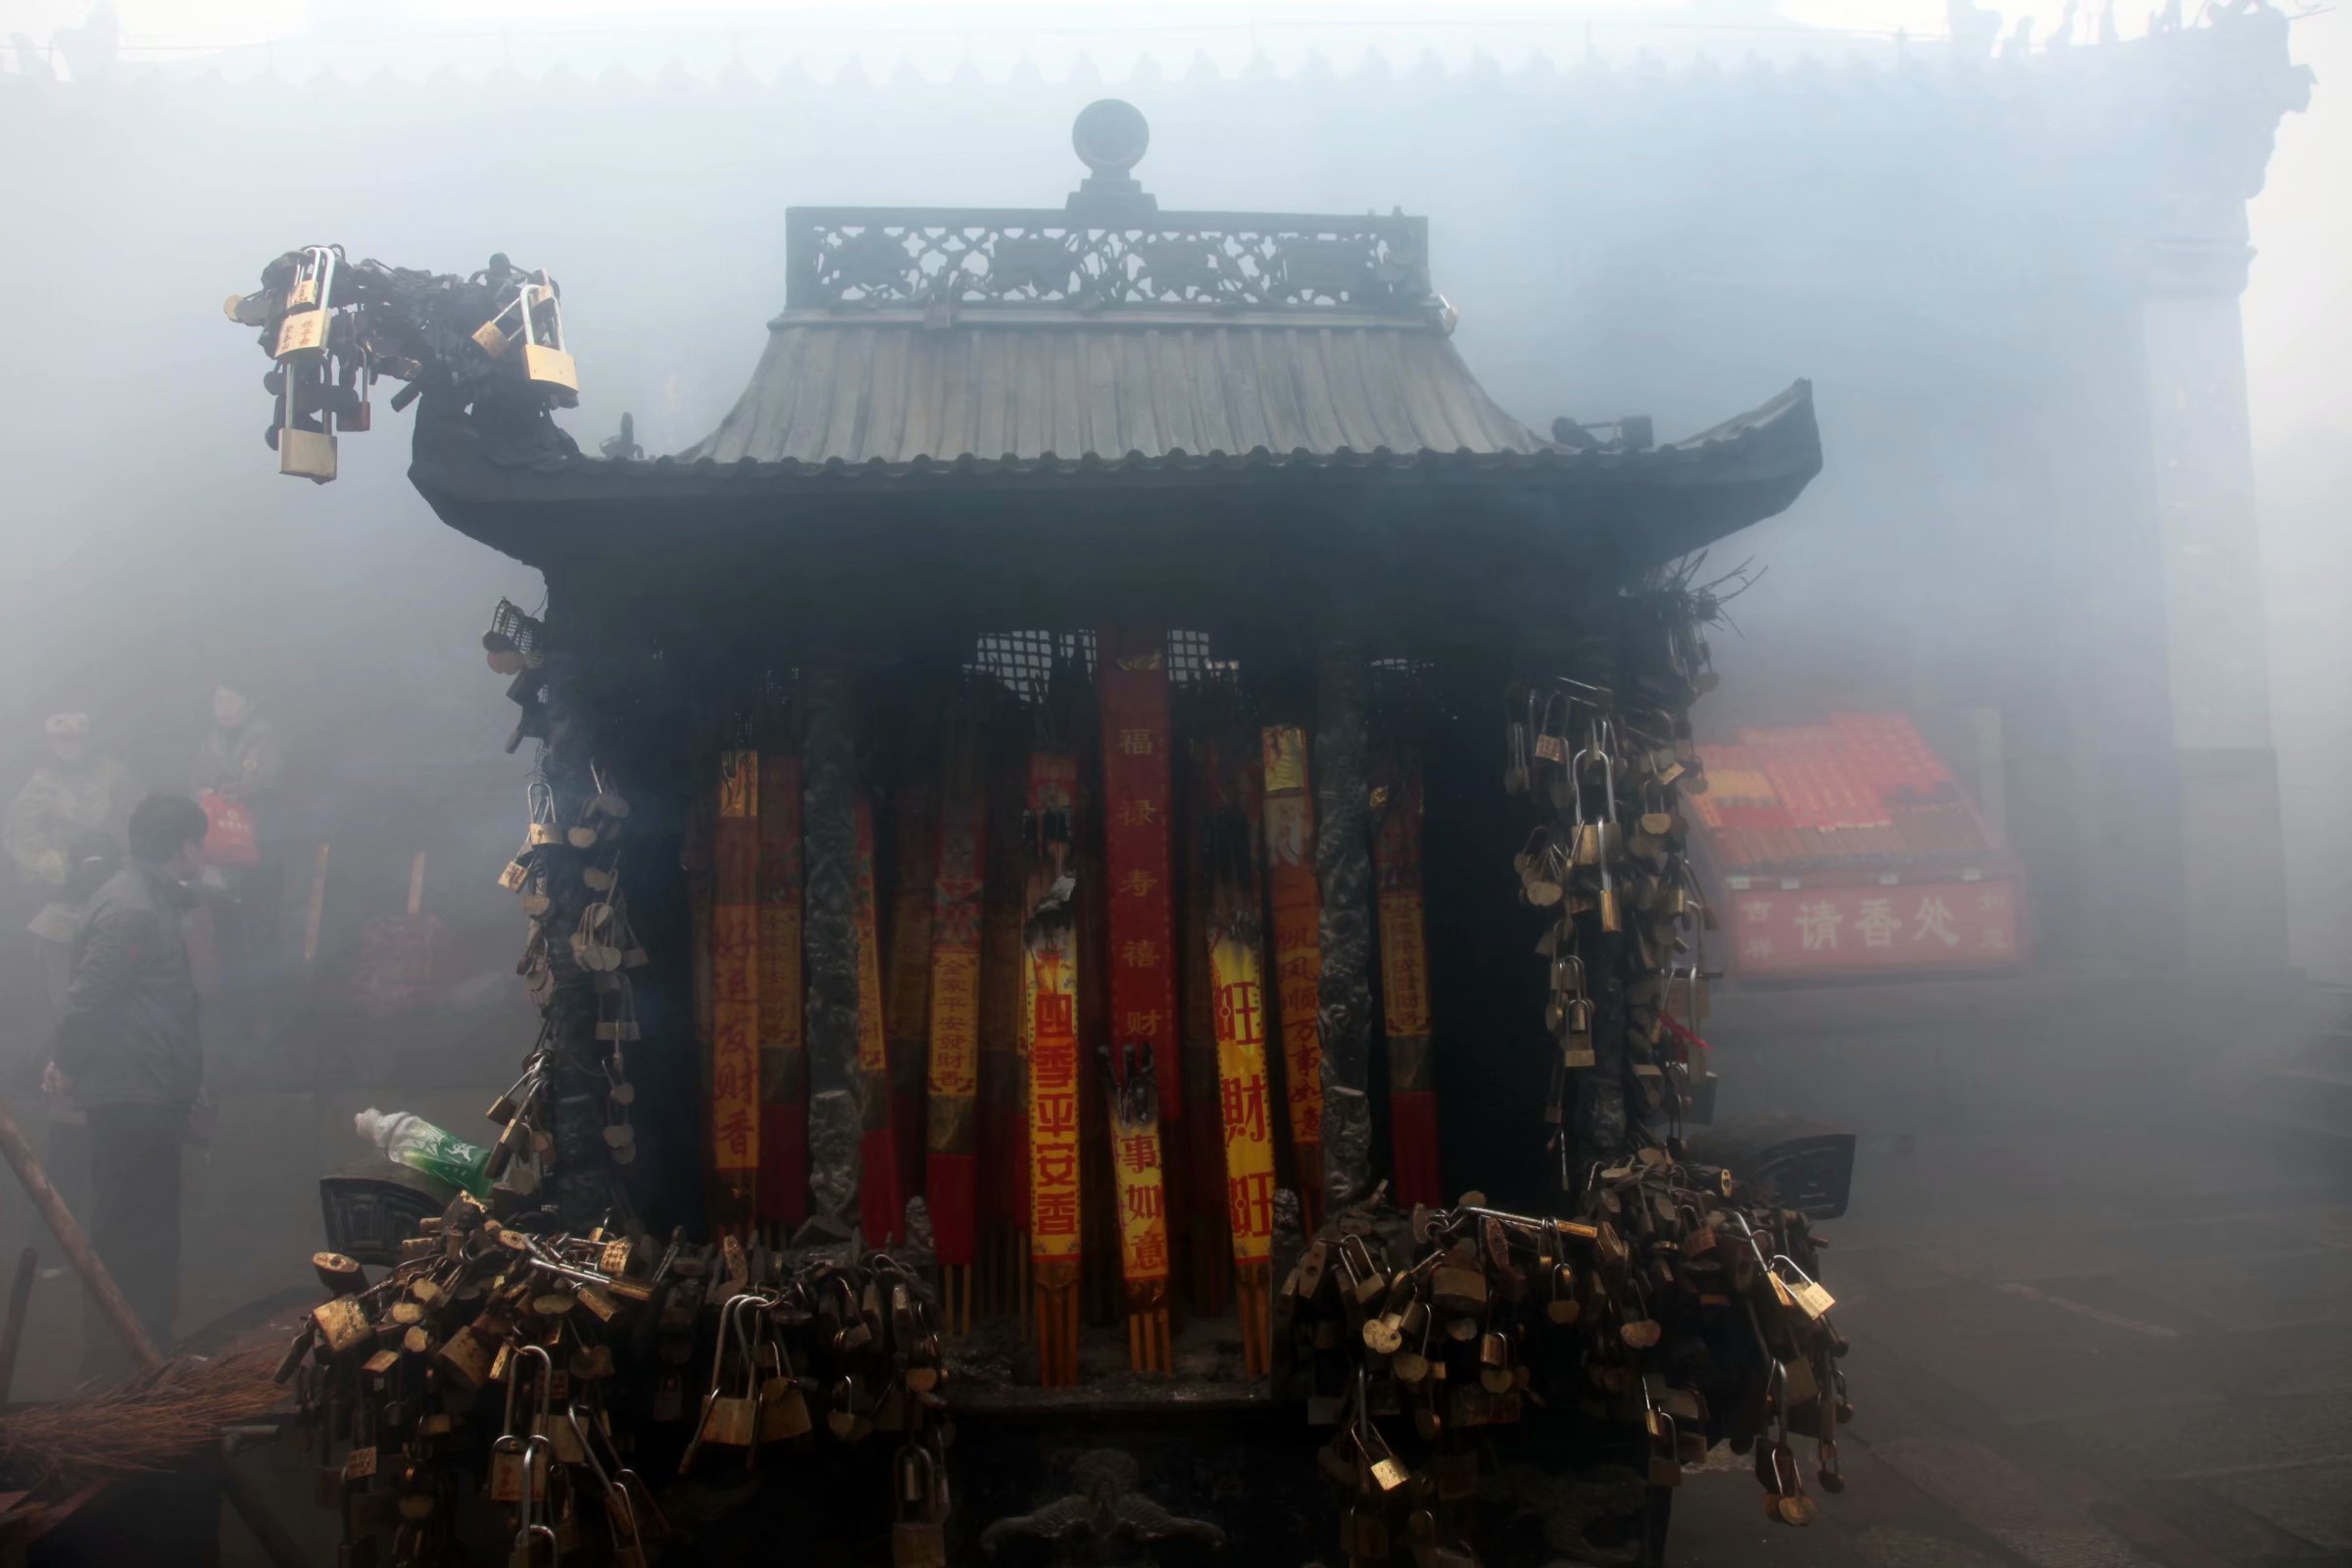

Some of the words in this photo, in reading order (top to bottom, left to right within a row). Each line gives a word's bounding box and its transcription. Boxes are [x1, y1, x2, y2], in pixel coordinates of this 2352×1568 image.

[1119, 728, 1162, 1035] 福禄寿禧财
[1792, 893, 1961, 951] 请香处
[1035, 994, 1075, 1234] 四季平安香
[1120, 1133, 1165, 1270] 事如意
